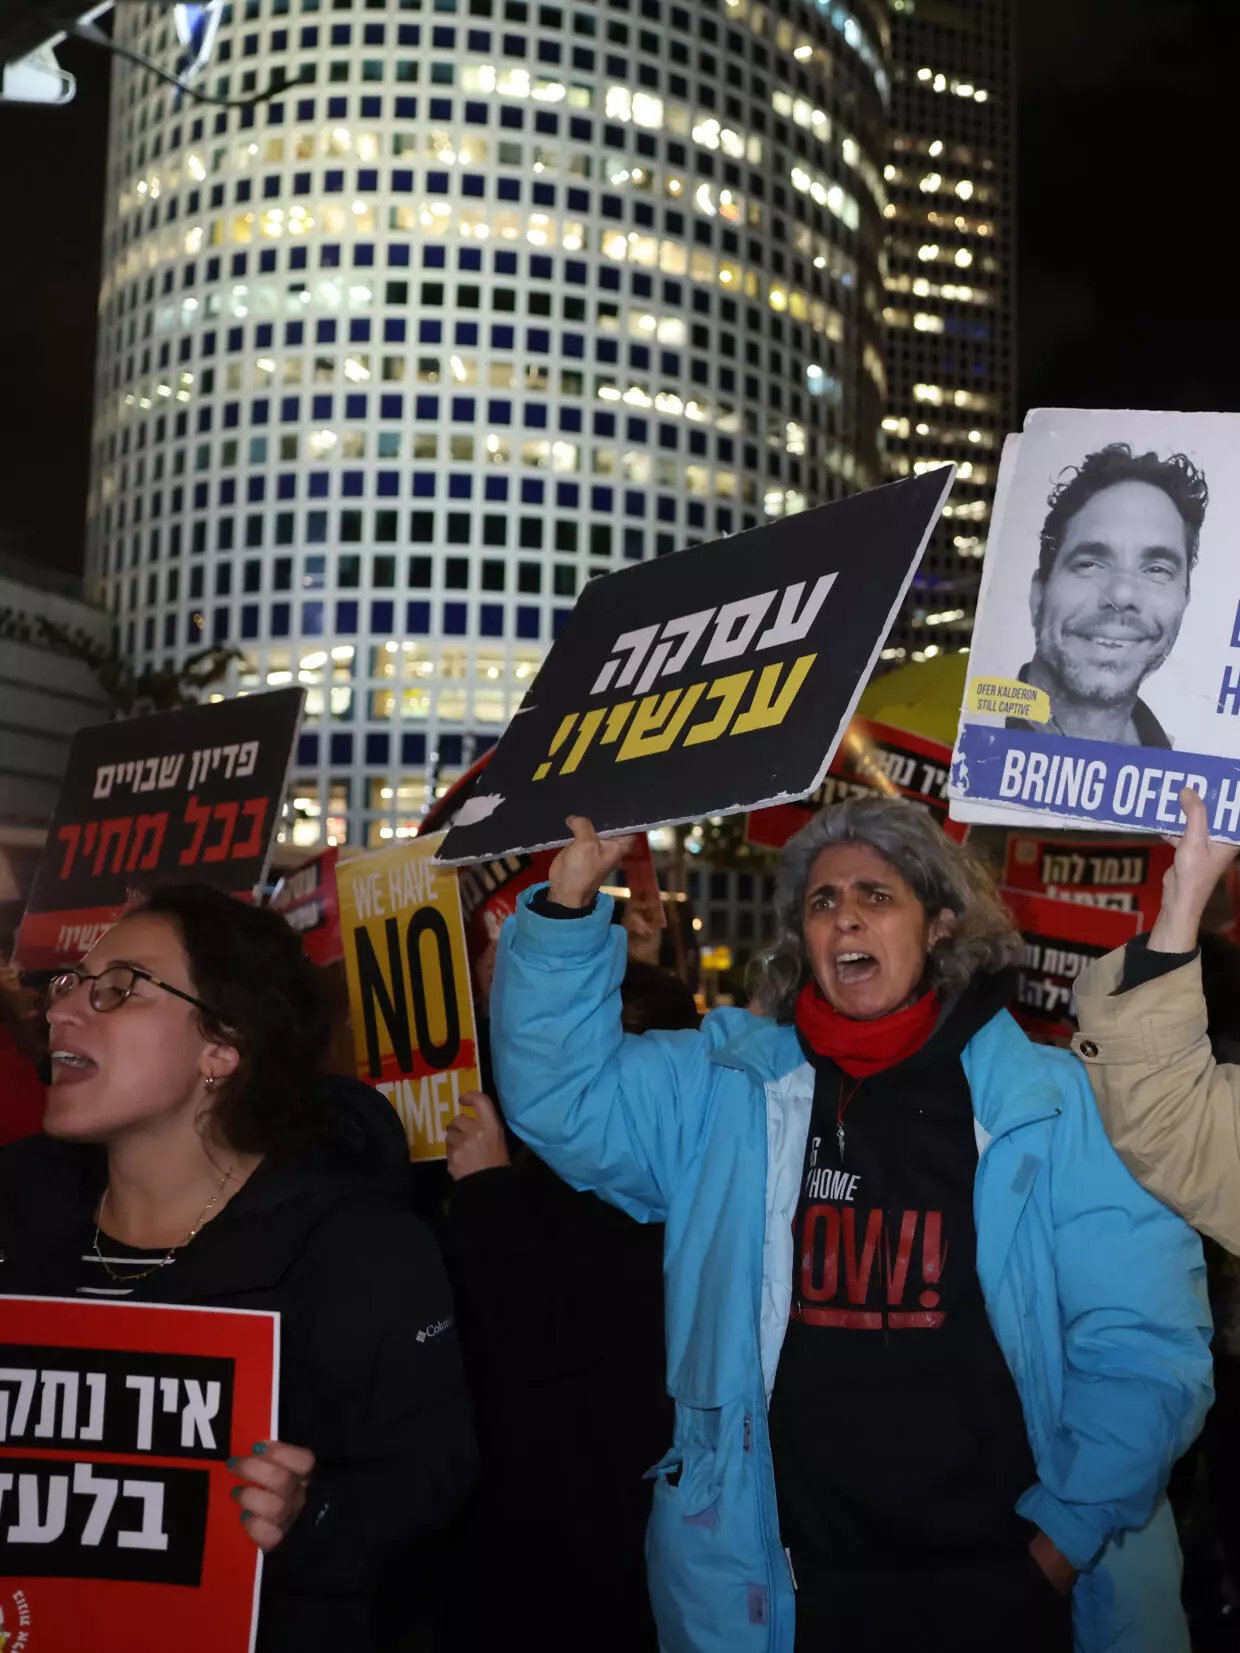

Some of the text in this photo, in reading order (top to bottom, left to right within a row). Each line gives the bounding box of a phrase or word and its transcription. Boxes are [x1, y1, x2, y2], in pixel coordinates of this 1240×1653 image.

[590, 572, 839, 696] עסקה
[532, 653, 818, 781] עכשיו!
[977, 683, 1038, 701] OFER KALDERON
[977, 698, 1031, 715] STILL CAPTIVE
[94, 741, 260, 799] פדיון שבויים
[1000, 749, 1106, 811] BRING
[57, 811, 168, 879] מחיר
[353, 872, 385, 921] WE
[388, 857, 439, 913] HAVE
[56, 922, 117, 953] שיו!
[354, 906, 460, 1079] NO
[808, 1169, 861, 1201] HOME
[802, 1204, 944, 1308] OW!
[426, 1320, 449, 1337] Colu
[126, 1376, 221, 1450] איך
